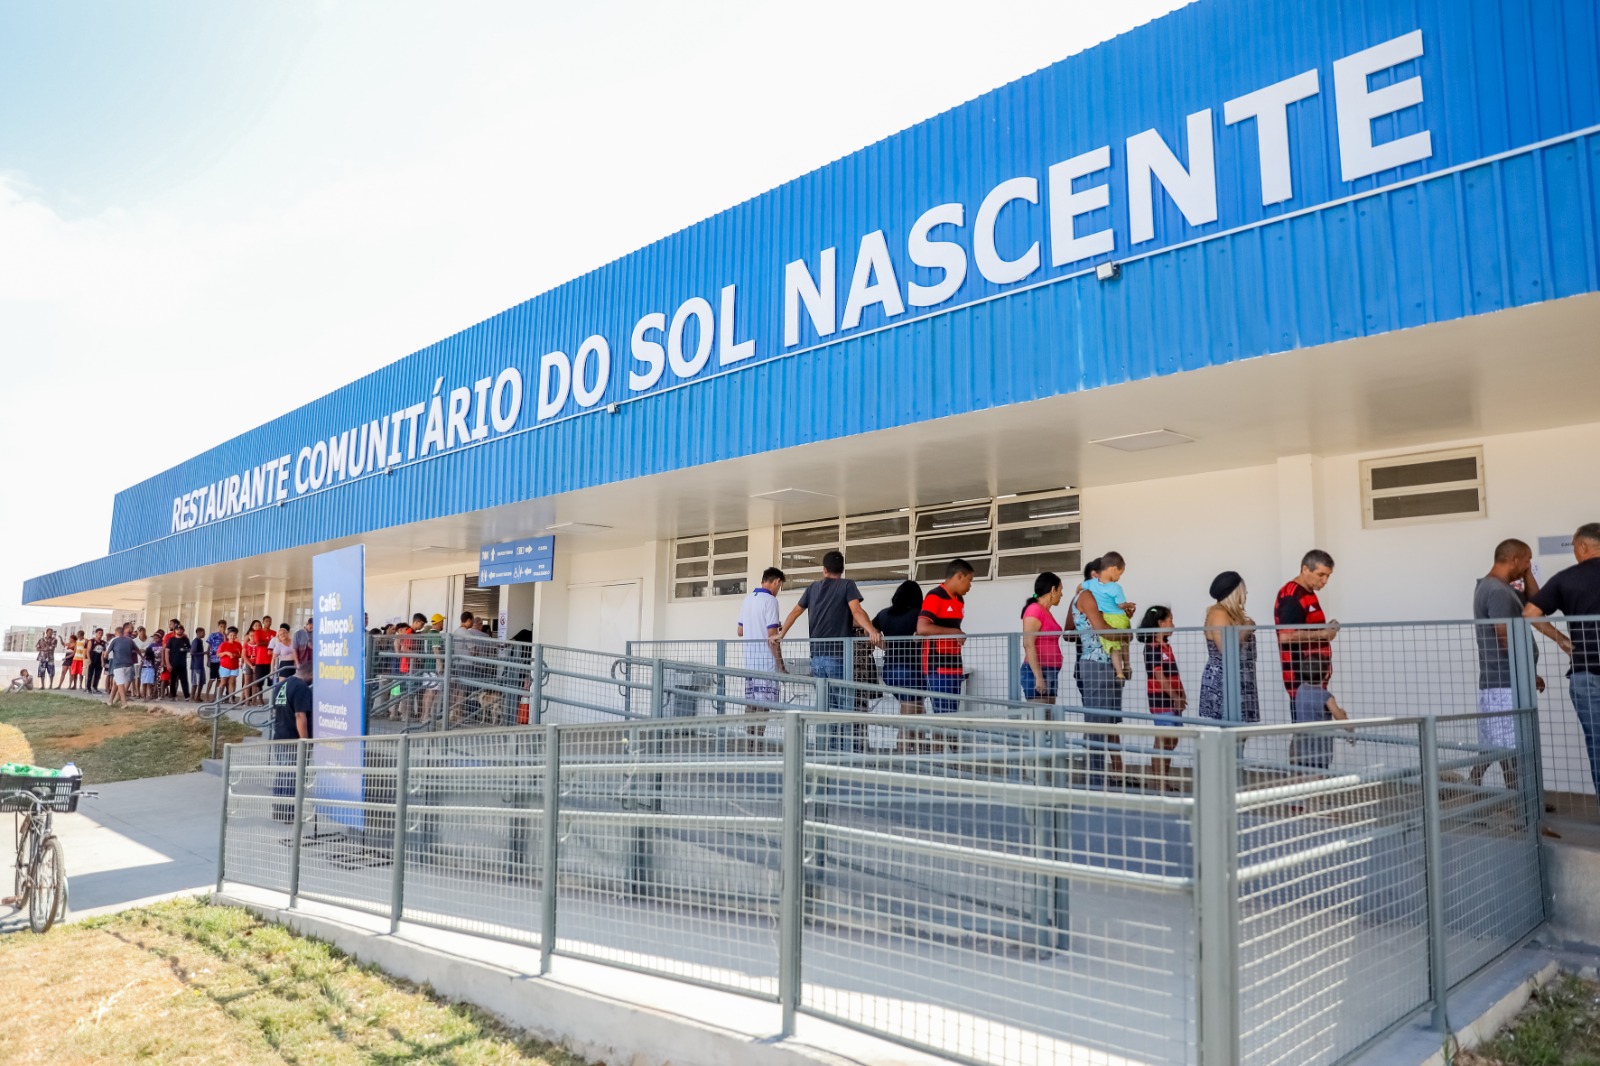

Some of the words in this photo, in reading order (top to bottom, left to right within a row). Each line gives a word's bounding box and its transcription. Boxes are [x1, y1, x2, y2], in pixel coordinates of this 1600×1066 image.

[170, 454, 291, 533] RESTAURANTE
[294, 367, 523, 495] COMUNITÁRIO
[537, 334, 610, 421] DO
[629, 284, 755, 392] SOL
[784, 29, 1433, 348] NASCENTE
[319, 659, 355, 685] Domingo
[318, 701, 348, 715] Restaurante
